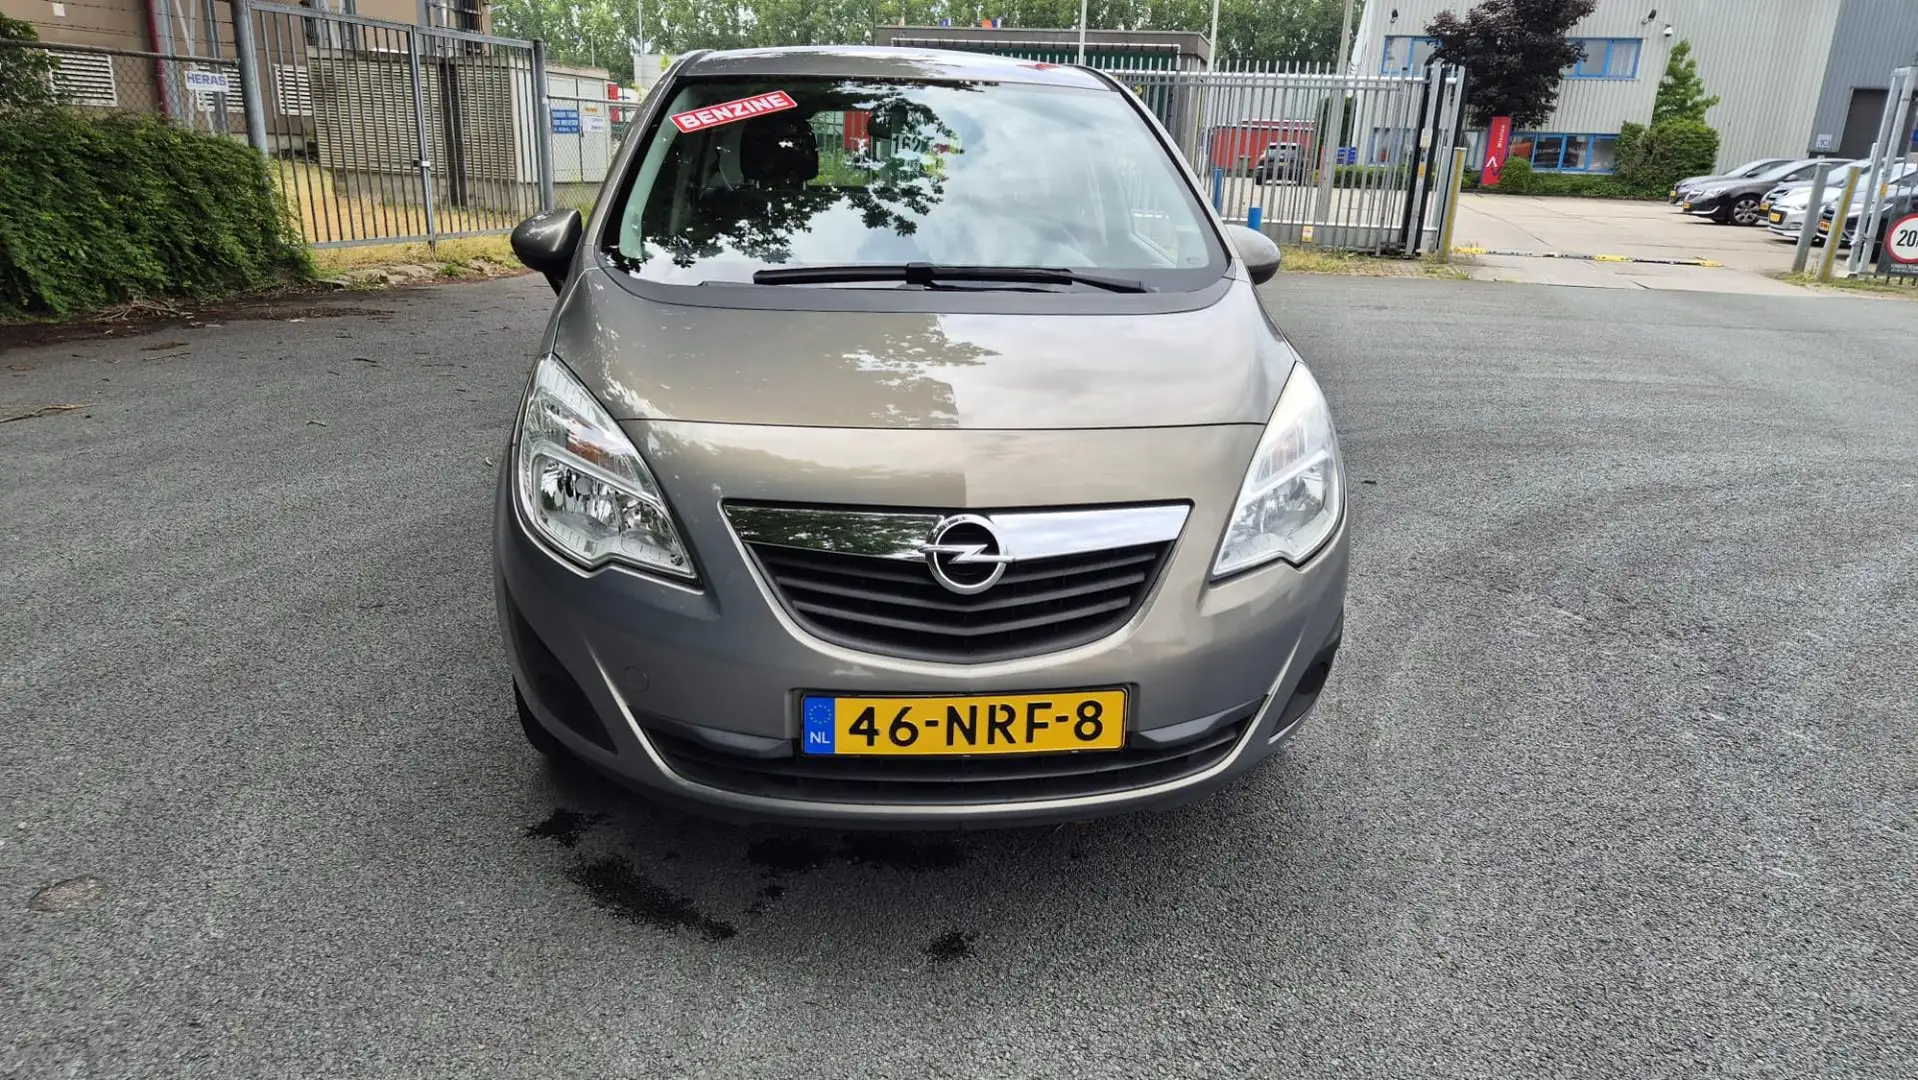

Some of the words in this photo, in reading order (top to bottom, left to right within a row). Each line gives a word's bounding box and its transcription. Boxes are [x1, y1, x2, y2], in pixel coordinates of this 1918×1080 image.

[187, 72, 227, 86] HERAS
[678, 94, 789, 129] BENZINE
[1896, 229, 1918, 247] 20
[848, 700, 1104, 747] 46-NRF-8
[810, 731, 831, 744] NL
